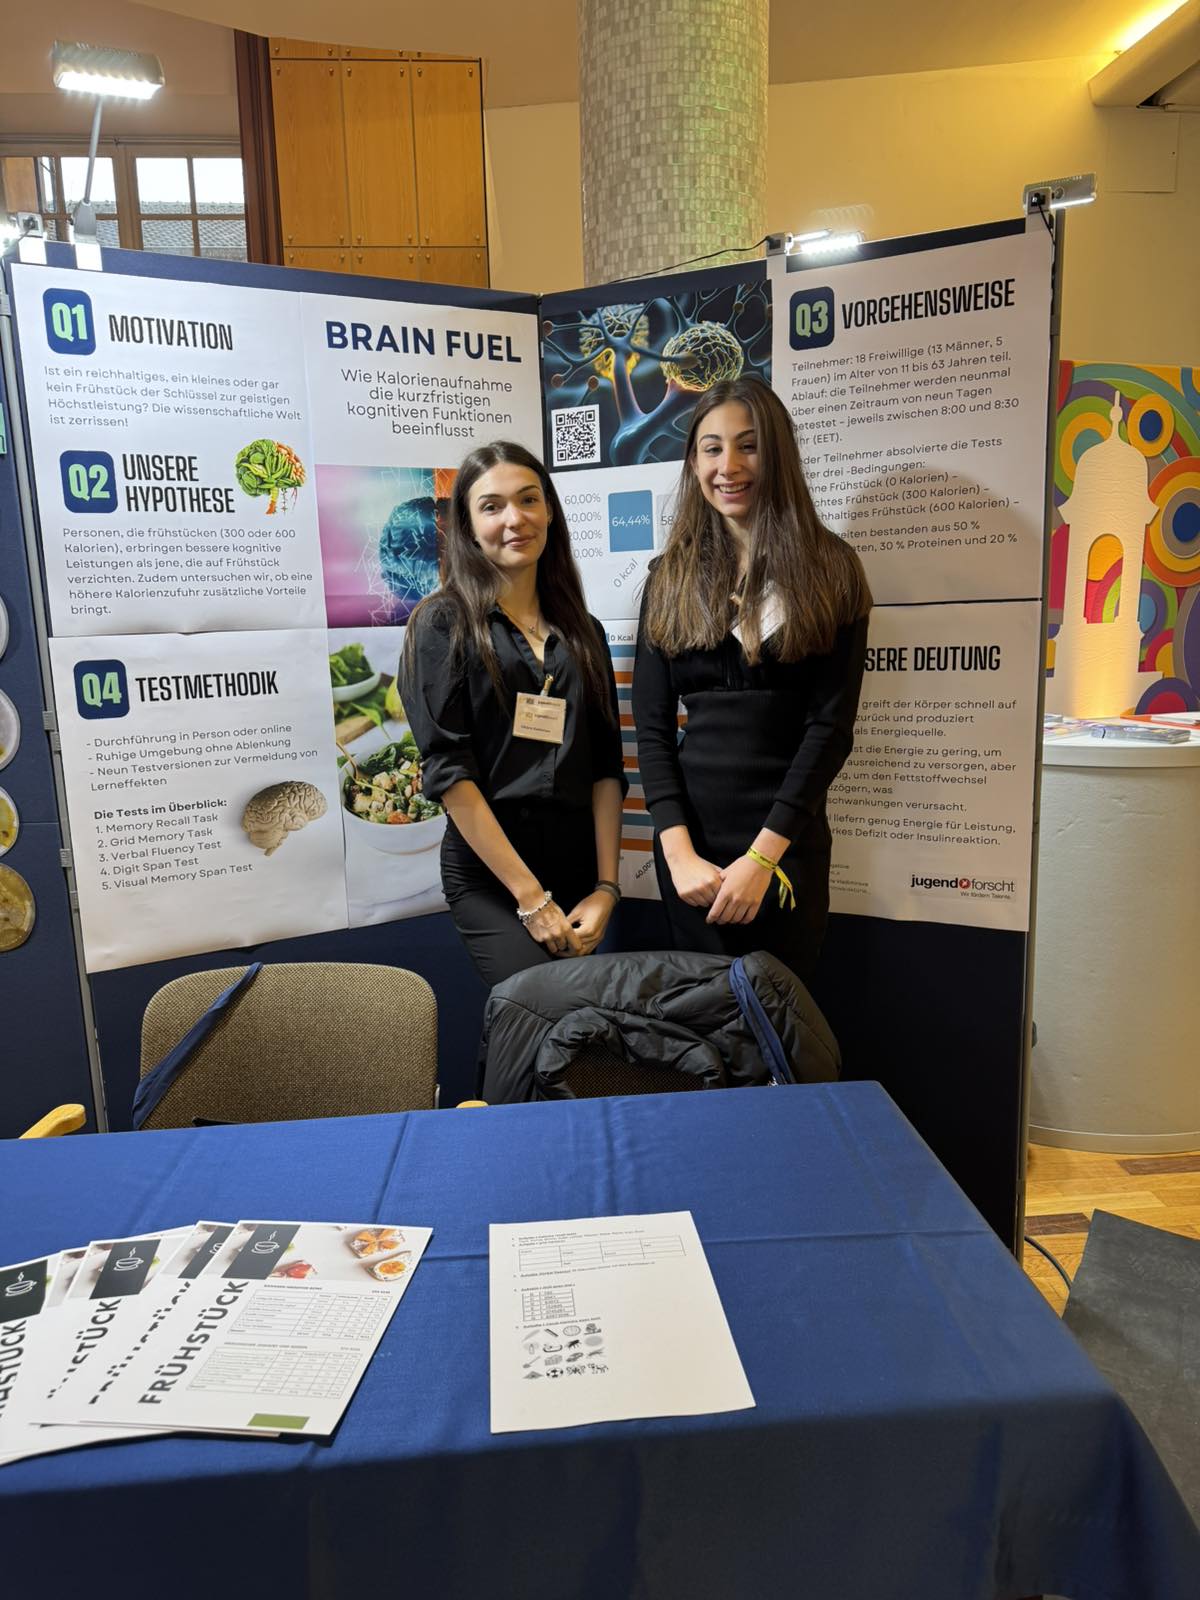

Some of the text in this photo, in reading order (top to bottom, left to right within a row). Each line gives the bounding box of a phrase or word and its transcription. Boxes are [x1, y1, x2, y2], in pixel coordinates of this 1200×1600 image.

[842, 278, 1016, 329] VORGEHENSWEISE
[51, 302, 88, 342] Q1
[795, 300, 828, 338] Q3
[108, 314, 234, 351] MOTIVATION
[325, 320, 522, 363] BRAIN FUEL
[792, 336, 1003, 371] Teilnehmer: 18 Freiwillige (13 Männer, 5
[44, 366, 279, 391] Ist ein reichhaltiges, ein kleines oder gar
[792, 351, 1011, 387] Frauen) im Alter von 11 bis 63 Jahren teil.
[341, 369, 512, 393] Wie Kalorienaufnahme
[791, 367, 1011, 401] Ablauf: die Teilnehmer werden neunmal
[46, 382, 290, 406] kein Frühstück der Schlüssel zur geistigen
[369, 387, 491, 409] die kurzfristigen
[48, 398, 301, 420] Höchstleistung? Die wissenschaftliche Welt
[347, 401, 512, 423] kognitiven Funktionen
[50, 414, 128, 427] ist zerrissen!
[392, 420, 474, 437] beeinflusst
[122, 453, 199, 482] UNSERE
[67, 463, 111, 501] Q2
[125, 486, 236, 513] HYPOTHESE
[564, 493, 601, 505] 60,00%
[611, 515, 650, 527] 64,44%
[63, 528, 296, 539] Personen, die frühstücken (300 oder 600
[64, 543, 281, 555] Kalorien), erbringen bessere kognitive
[66, 558, 280, 570] Leistungen als jene, die auf Frühstück
[619, 558, 638, 580] kcal
[67, 572, 313, 584] verzichten. Zudem untersuchen wir, ob eine
[69, 586, 306, 599] höhere Kalorienzufuhr zusätzliche Vorteile
[70, 605, 111, 616] bringt.
[617, 634, 634, 642] Kcal
[864, 645, 1001, 672] SERE DEUTUNG
[81, 672, 122, 708] Q4
[135, 670, 279, 703] TESTMETHODIK
[863, 699, 1017, 710] greift der Körper schnell auf
[94, 724, 292, 747] Durchführung in Person oder online
[854, 727, 946, 738] als Energiequelle.
[96, 739, 291, 764] Ruhige Umgebung ohne Ablenkung
[97, 765, 128, 776] Neun
[131, 760, 212, 773] Testversionen
[214, 755, 231, 766] zur
[234, 752, 297, 764] Vermeidung
[91, 776, 167, 791] Lerneffekten
[94, 799, 227, 820] Die Tests im Überblick:
[96, 813, 218, 834] 1. Memory Recall Task
[834, 814, 1016, 834] liefern genug Energie für Leistung,
[97, 828, 213, 848] 2. Grid Memory Task
[99, 841, 221, 862] 3. Verbal Fluency Test
[100, 857, 199, 876] 4. Digit Span Test
[102, 864, 253, 890] 5. Visual Memory Span Test
[910, 874, 1015, 893] jugend forscht
[138, 1280, 250, 1405] FRÜHSTÜCK
